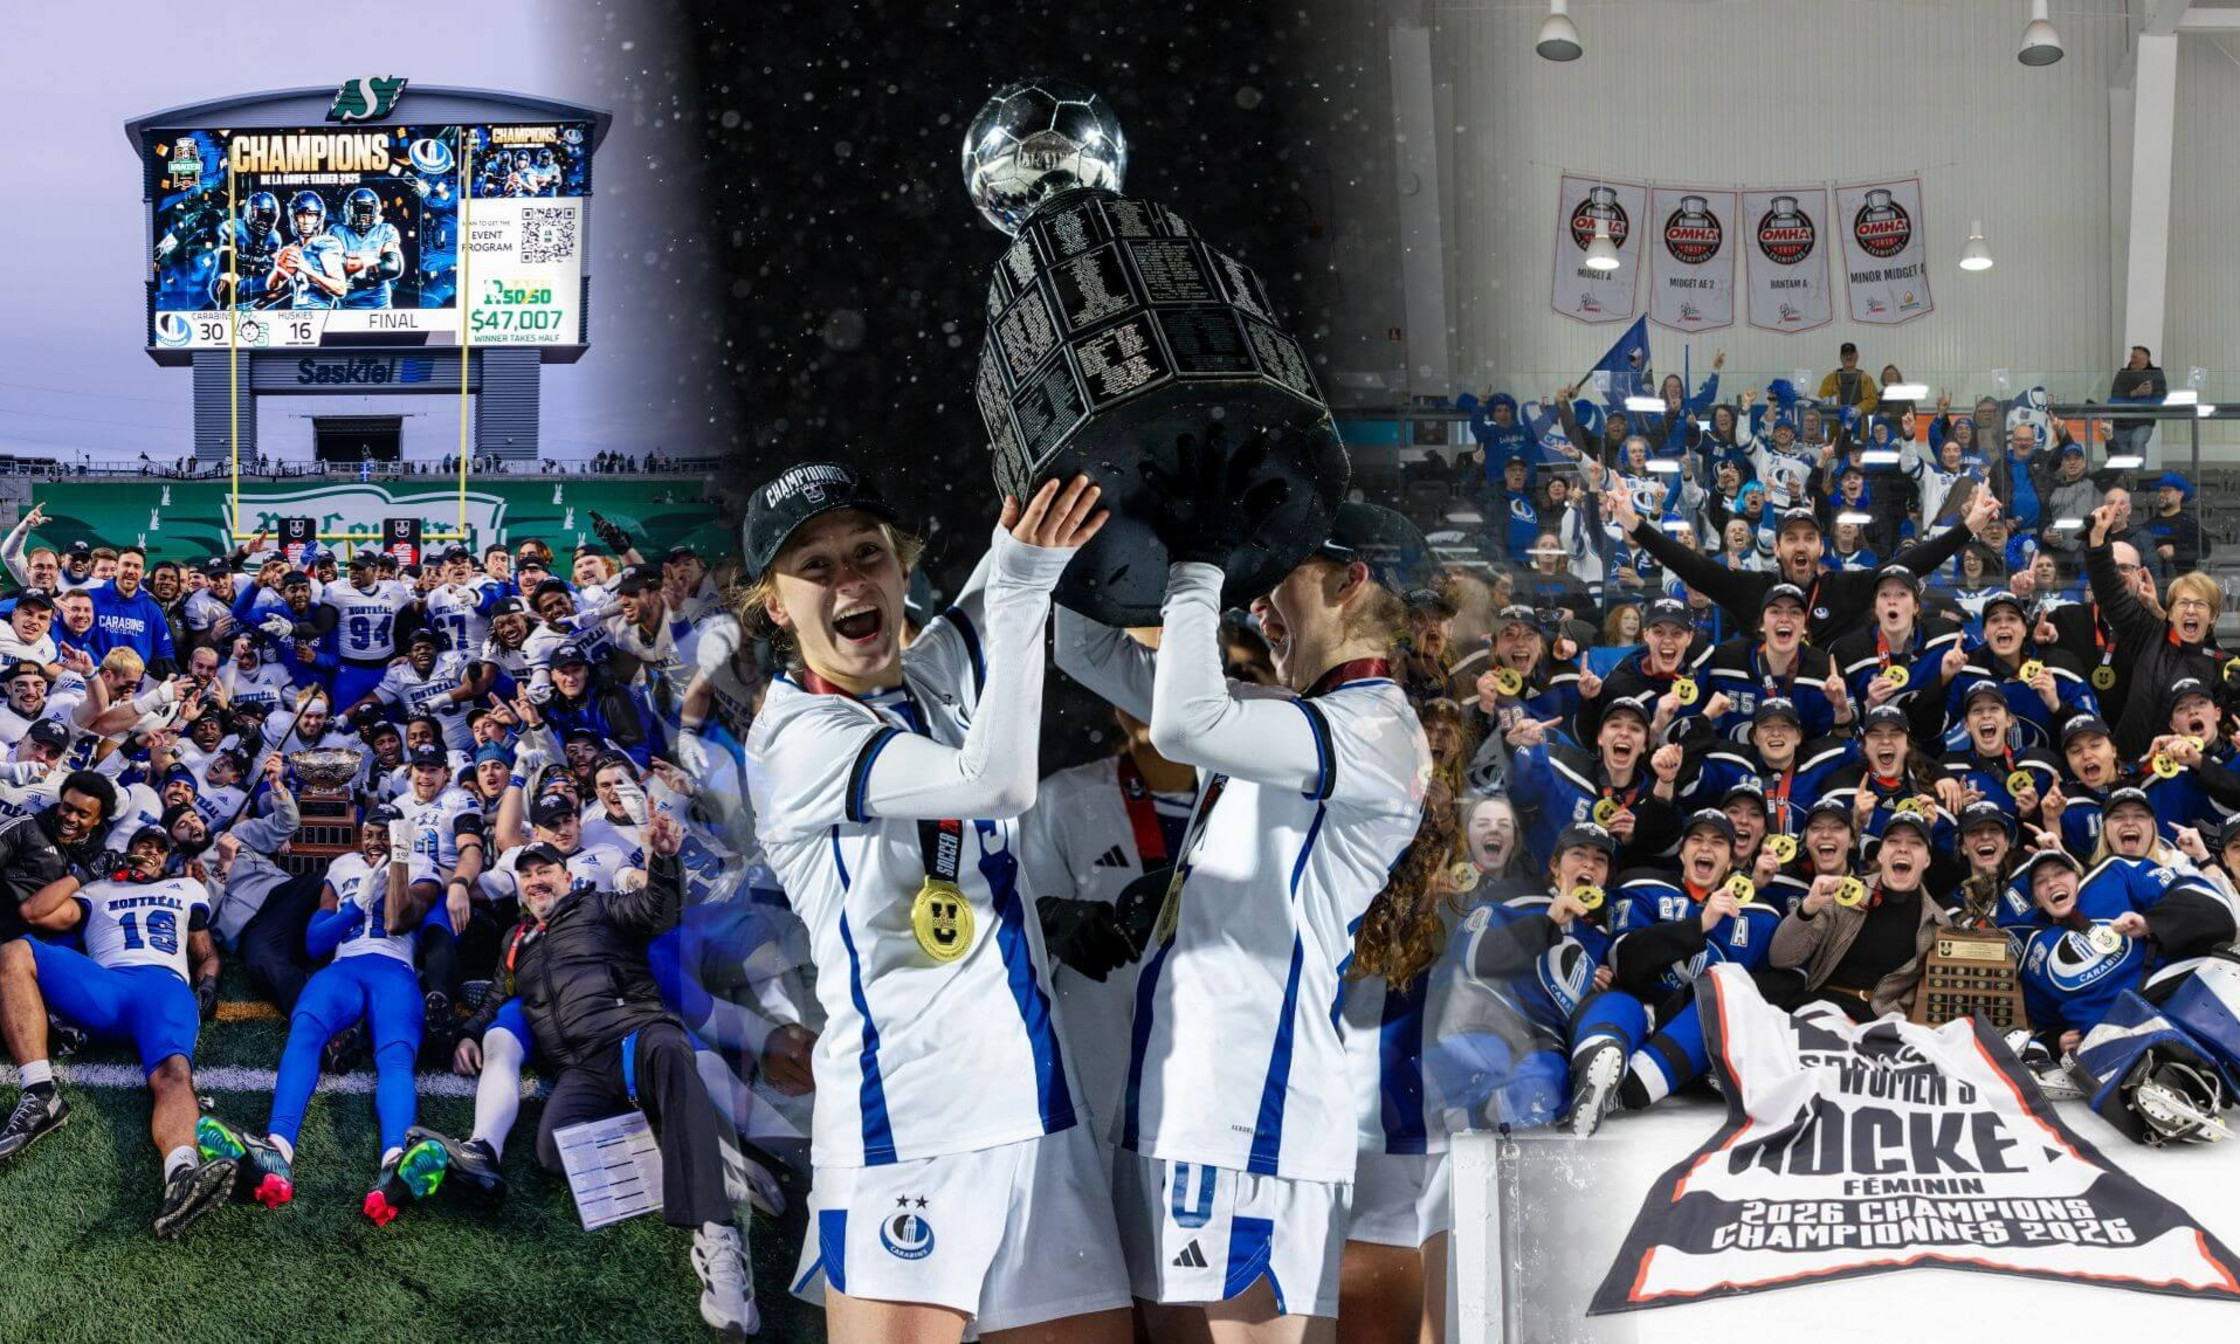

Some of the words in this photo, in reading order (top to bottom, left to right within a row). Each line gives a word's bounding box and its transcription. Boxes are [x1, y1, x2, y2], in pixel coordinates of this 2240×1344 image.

[492, 127, 557, 144] CHAMPIONS
[232, 134, 389, 173] CHAMPIONS
[472, 230, 503, 240] EVENT
[1667, 227, 1719, 242] OMHA
[1761, 228, 1812, 242] OMHA
[1858, 219, 1909, 236] OMHA
[1577, 268, 1605, 281] MIDGET
[1669, 278, 1697, 290] MIDGET
[1850, 269, 1882, 284] MINOR
[1884, 265, 1918, 281] MIDGET
[1770, 280, 1800, 290] BANTAM
[278, 311, 313, 320] HUSKIES
[368, 313, 419, 329] FINAL
[471, 308, 563, 332] $47,007
[200, 322, 224, 340] 30
[289, 322, 312, 340] 16
[475, 335, 508, 343] WINNER
[510, 334, 537, 343] TAKES
[539, 334, 560, 343] HALF
[297, 356, 396, 385] SaskTel
[99, 614, 145, 633] CARABINS
[105, 626, 139, 638] FOOTBALL
[349, 614, 394, 651] 94
[1727, 688, 1756, 715] 55
[1573, 796, 1592, 822] 5
[936, 832, 959, 877] SOCCER
[108, 894, 184, 911] MONTRÉAL
[1658, 895, 1689, 922] 27
[2004, 886, 2032, 917] A
[118, 909, 179, 955] 19
[1730, 916, 1749, 948] A
[1843, 1176, 1986, 1196] FÉMININ
[1739, 1200, 1845, 1225] 2026
[1858, 1196, 2097, 1223] CHAMPIONS
[1710, 1217, 2010, 1250] CHAMPIONNES
[2023, 1218, 2137, 1245] 2026
